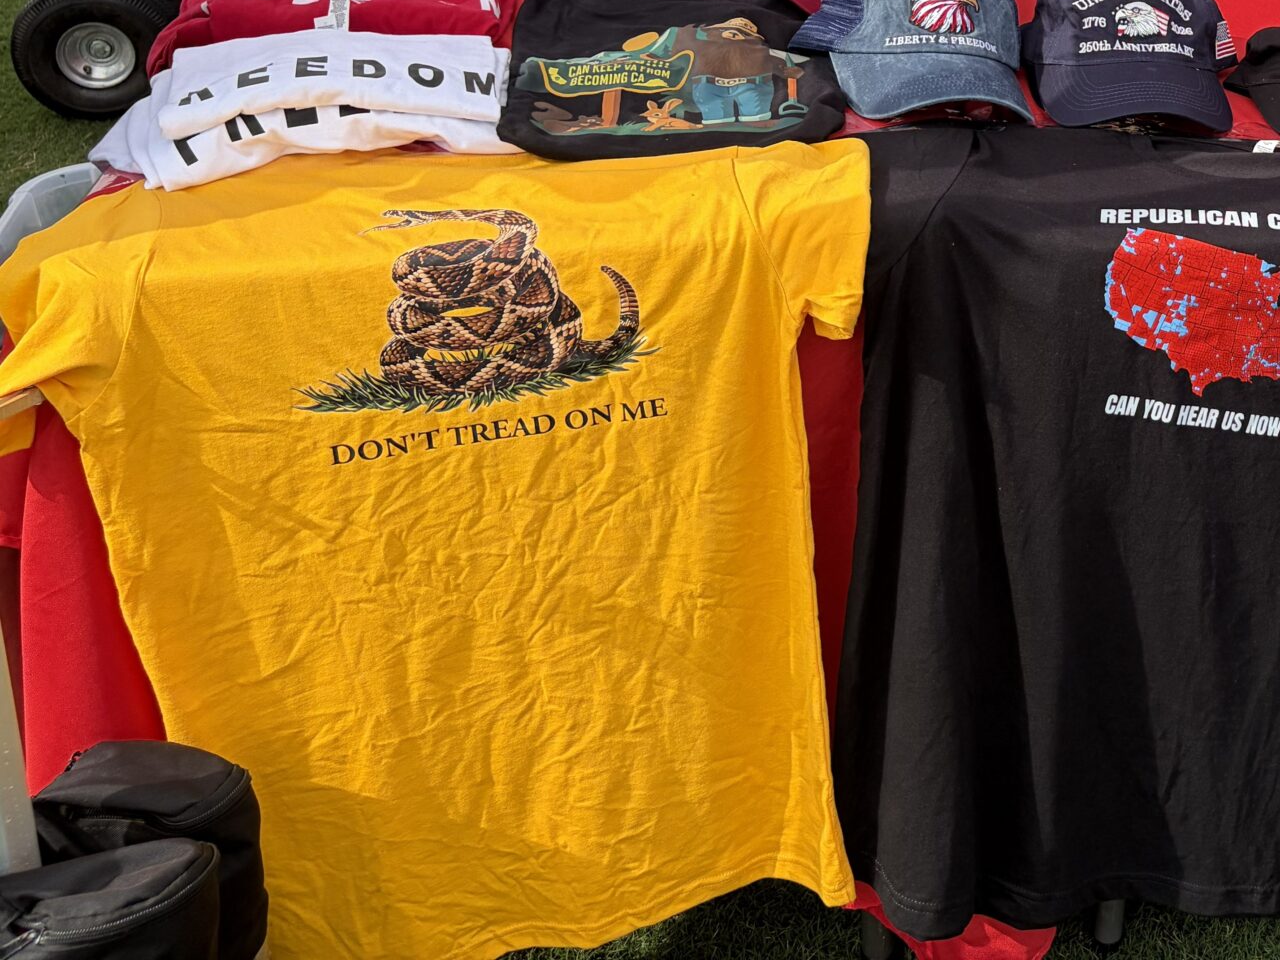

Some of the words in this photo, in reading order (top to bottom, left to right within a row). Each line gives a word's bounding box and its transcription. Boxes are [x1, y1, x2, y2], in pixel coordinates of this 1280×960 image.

[1082, 16, 1107, 29] 1776
[884, 34, 937, 47] LIBERTY
[938, 35, 949, 44] &
[1079, 40, 1112, 54] 250th
[1113, 39, 1195, 59] ANNIVERSARY
[568, 63, 591, 79] CAN
[569, 74, 628, 87] BECOMING
[630, 72, 645, 84] CA
[1100, 208, 1259, 228] REPUBLICAN
[1104, 393, 1140, 417] CAN
[1142, 398, 1174, 424] YOU
[1176, 404, 1218, 429] HEAR
[1220, 410, 1243, 432] US
[330, 428, 440, 466] DON'T
[447, 413, 556, 447] TREAD
[564, 403, 613, 430] ON
[620, 397, 669, 422] ME
